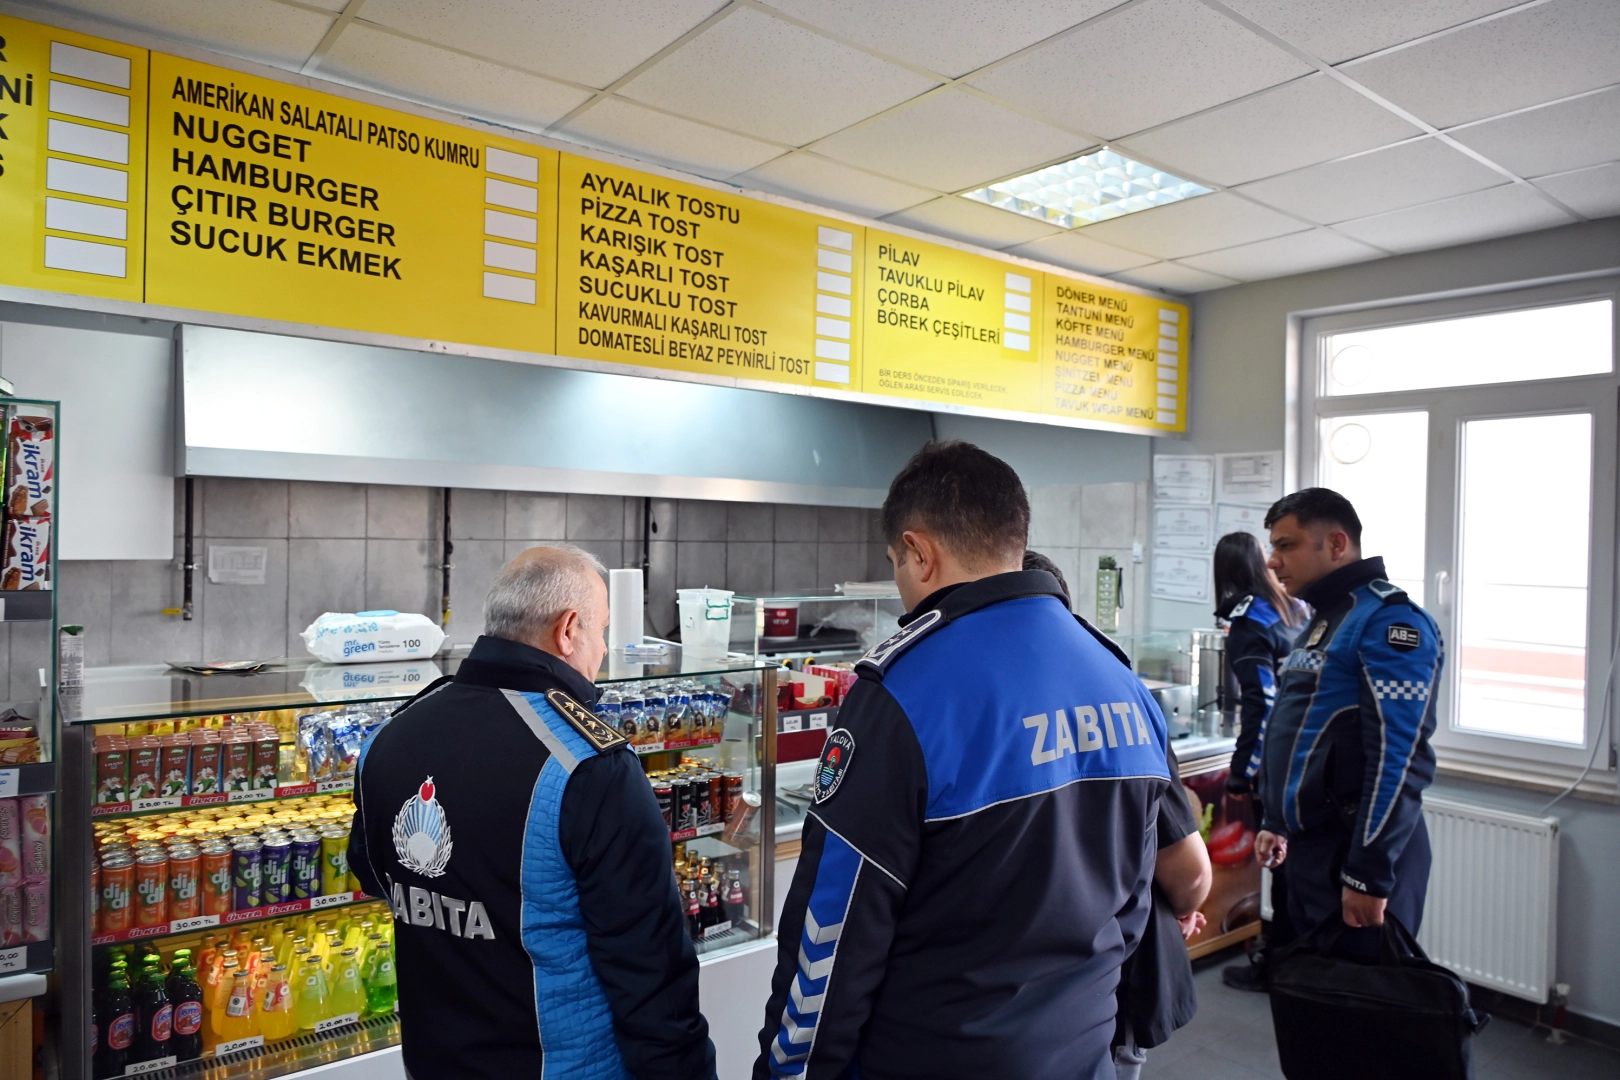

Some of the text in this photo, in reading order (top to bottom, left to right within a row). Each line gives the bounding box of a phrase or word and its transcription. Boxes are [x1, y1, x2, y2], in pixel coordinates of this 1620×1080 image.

[172, 76, 479, 169] AMERİKAN SALATALI PATSO KUMRU
[173, 111, 312, 162] NUGGET
[173, 147, 380, 211] HAMBURGER
[580, 172, 740, 224] AYVALIK TOSTU
[171, 184, 396, 247] ÇITIR BURGER
[581, 196, 700, 239] PİZZA TOST
[170, 220, 402, 280] SUCUK EKMEK
[580, 223, 724, 268] KARIŞIK TOST
[878, 243, 920, 267] PİLAV
[580, 249, 730, 293] KAŞARLI TOST
[878, 266, 985, 302] TAVUKLU PİLAV
[579, 275, 738, 318] SUCUKLU TOST
[877, 288, 930, 311] ÇORBA
[1057, 286, 1127, 312] DÖNER MENÜ
[579, 301, 767, 346] KAVURMALI KAŞARLI TOST
[1057, 302, 1134, 329] TANTUNİ MENÜ
[877, 308, 1000, 345] BÖREK ÇEŞİTLERİ
[1056, 318, 1124, 342] KÖFTE MENÜ
[578, 327, 810, 375] DOMATESLİ BEYAZ PEYNİRLİ TOST
[1056, 334, 1155, 361] HAMBURGER MENÜ
[1055, 350, 1133, 372] NUGGET MENÜ
[879, 379, 903, 389] ÖĞLEN
[904, 382, 925, 392] ARASI
[893, 370, 912, 380] DERS
[913, 370, 946, 385] ÖNCEDEN
[1106, 373, 1133, 388] MENÜ
[1055, 381, 1118, 400] PİZZA MENÜ
[1055, 397, 1154, 420] TAVUK WRAP MENÜ
[22, 443, 42, 499] ikram
[19, 525, 36, 582] ikram
[343, 642, 375, 657] green
[403, 639, 421, 648] 100
[829, 734, 851, 751] YALOVA
[1022, 702, 1151, 766] ZABITA
[189, 795, 225, 806] ÜLKER
[231, 793, 253, 801] 20.00
[282, 785, 315, 796] ÜLKER
[92, 804, 131, 816] ÜLKER
[263, 859, 277, 875] di
[293, 855, 306, 870] di
[299, 864, 316, 880] di
[138, 878, 155, 894] di
[171, 873, 188, 889] di
[269, 869, 286, 885] di
[103, 882, 120, 899] di
[146, 882, 166, 905] di
[179, 878, 197, 899] di
[111, 890, 130, 910] di
[267, 902, 302, 915] ÜLKER
[314, 897, 337, 907] 30.00
[175, 920, 202, 930] 30.00
[226, 910, 262, 922] ÜLKER
[129, 925, 168, 938] ÜLKER
[319, 1019, 343, 1030] 20.00
[224, 1041, 247, 1052] 20.00
[133, 1062, 158, 1073] 20.00
